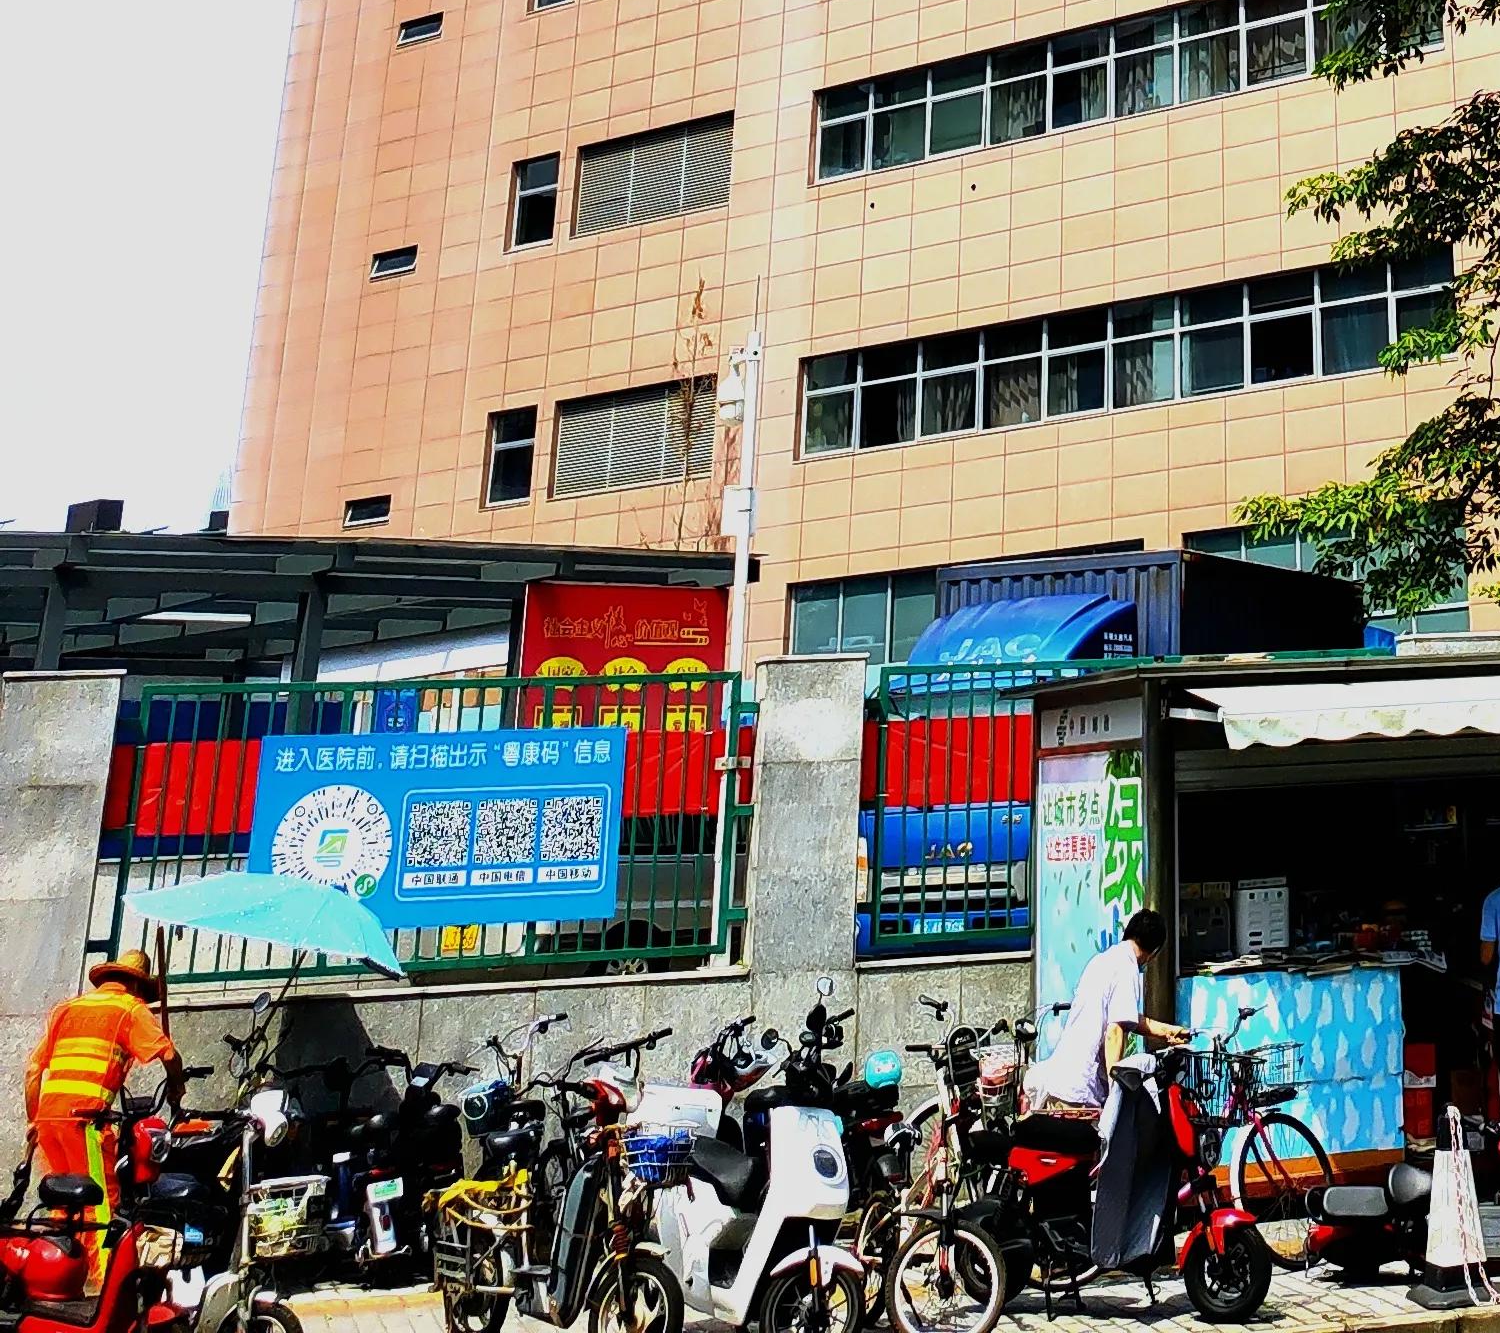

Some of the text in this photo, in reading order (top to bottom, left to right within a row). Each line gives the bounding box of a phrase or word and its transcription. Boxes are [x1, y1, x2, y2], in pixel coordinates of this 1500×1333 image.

[940, 634, 1041, 662] JAC
[1043, 789, 1101, 827] 让城市多点
[1103, 780, 1144, 918] 绿
[479, 868, 525, 883] 中国电信
